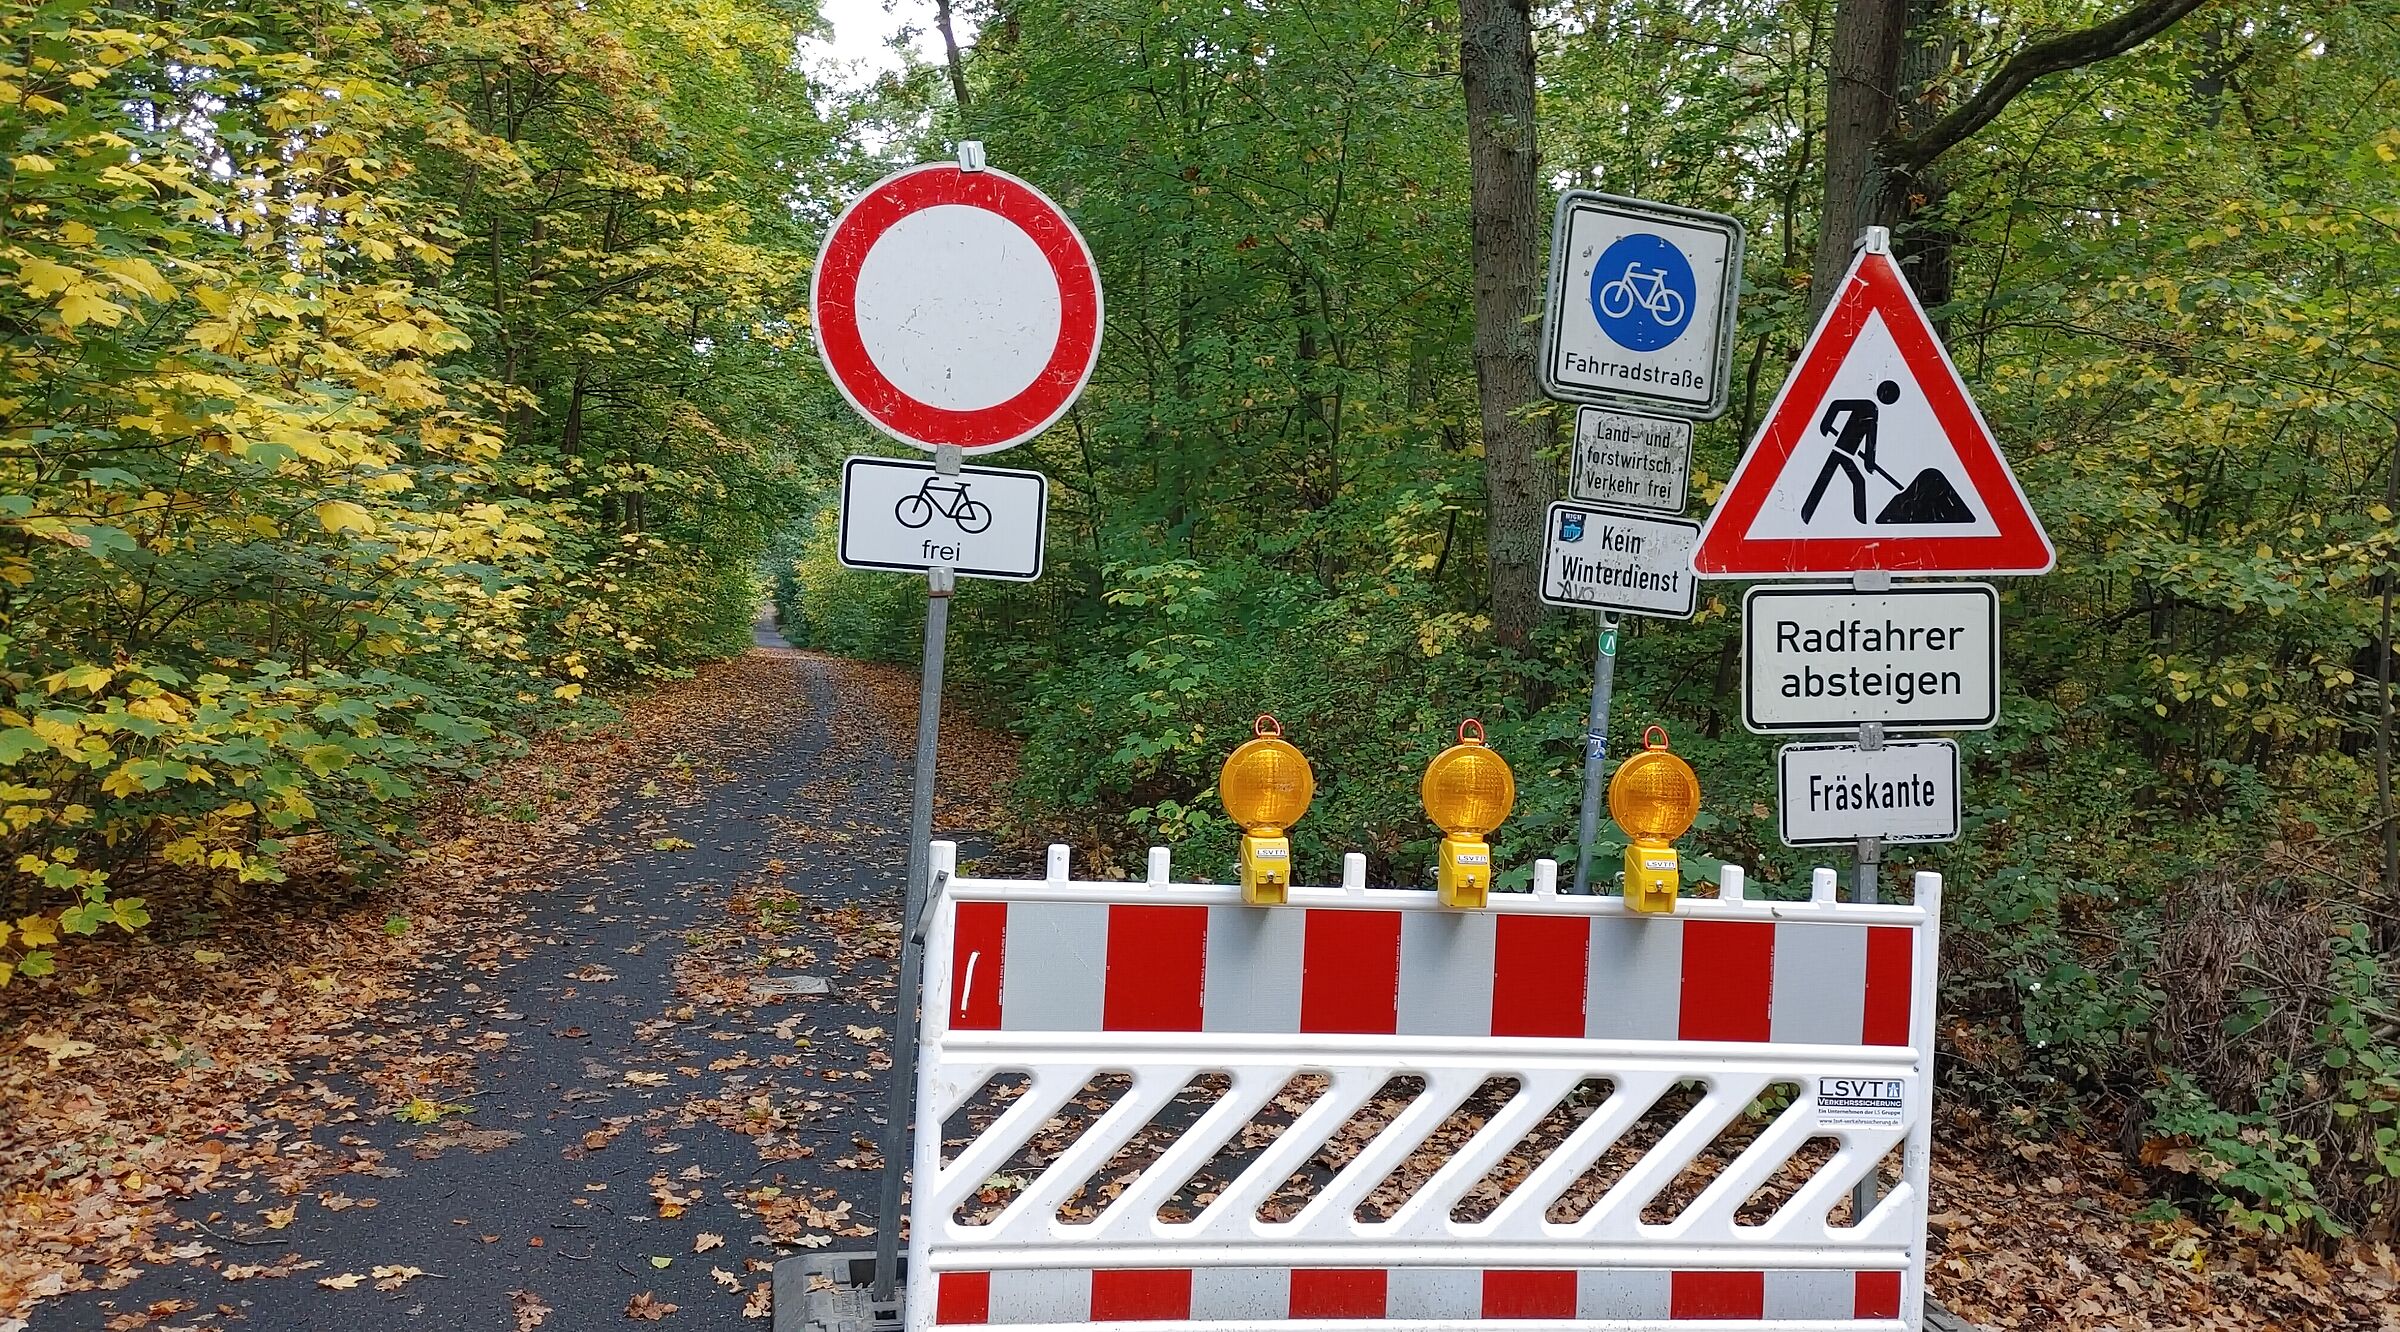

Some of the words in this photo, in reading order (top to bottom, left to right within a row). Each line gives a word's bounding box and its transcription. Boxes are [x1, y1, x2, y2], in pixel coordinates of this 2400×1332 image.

[1565, 352, 1704, 389] Fahrradstraße
[1597, 421, 1638, 443] Land-
[1645, 431, 1671, 448] und
[1587, 445, 1675, 474] forstwirtsch.
[1586, 470, 1640, 494] Verkehr
[1648, 479, 1672, 499] frei
[922, 539, 961, 562] frei
[1601, 525, 1642, 554] Kein
[1562, 555, 1679, 593] Winterdienst
[1776, 619, 1966, 653] Radfahrer
[1780, 663, 1962, 705] absteigen
[1809, 772, 1935, 812] Fräskante
[1819, 1080, 1884, 1098] LSVT
